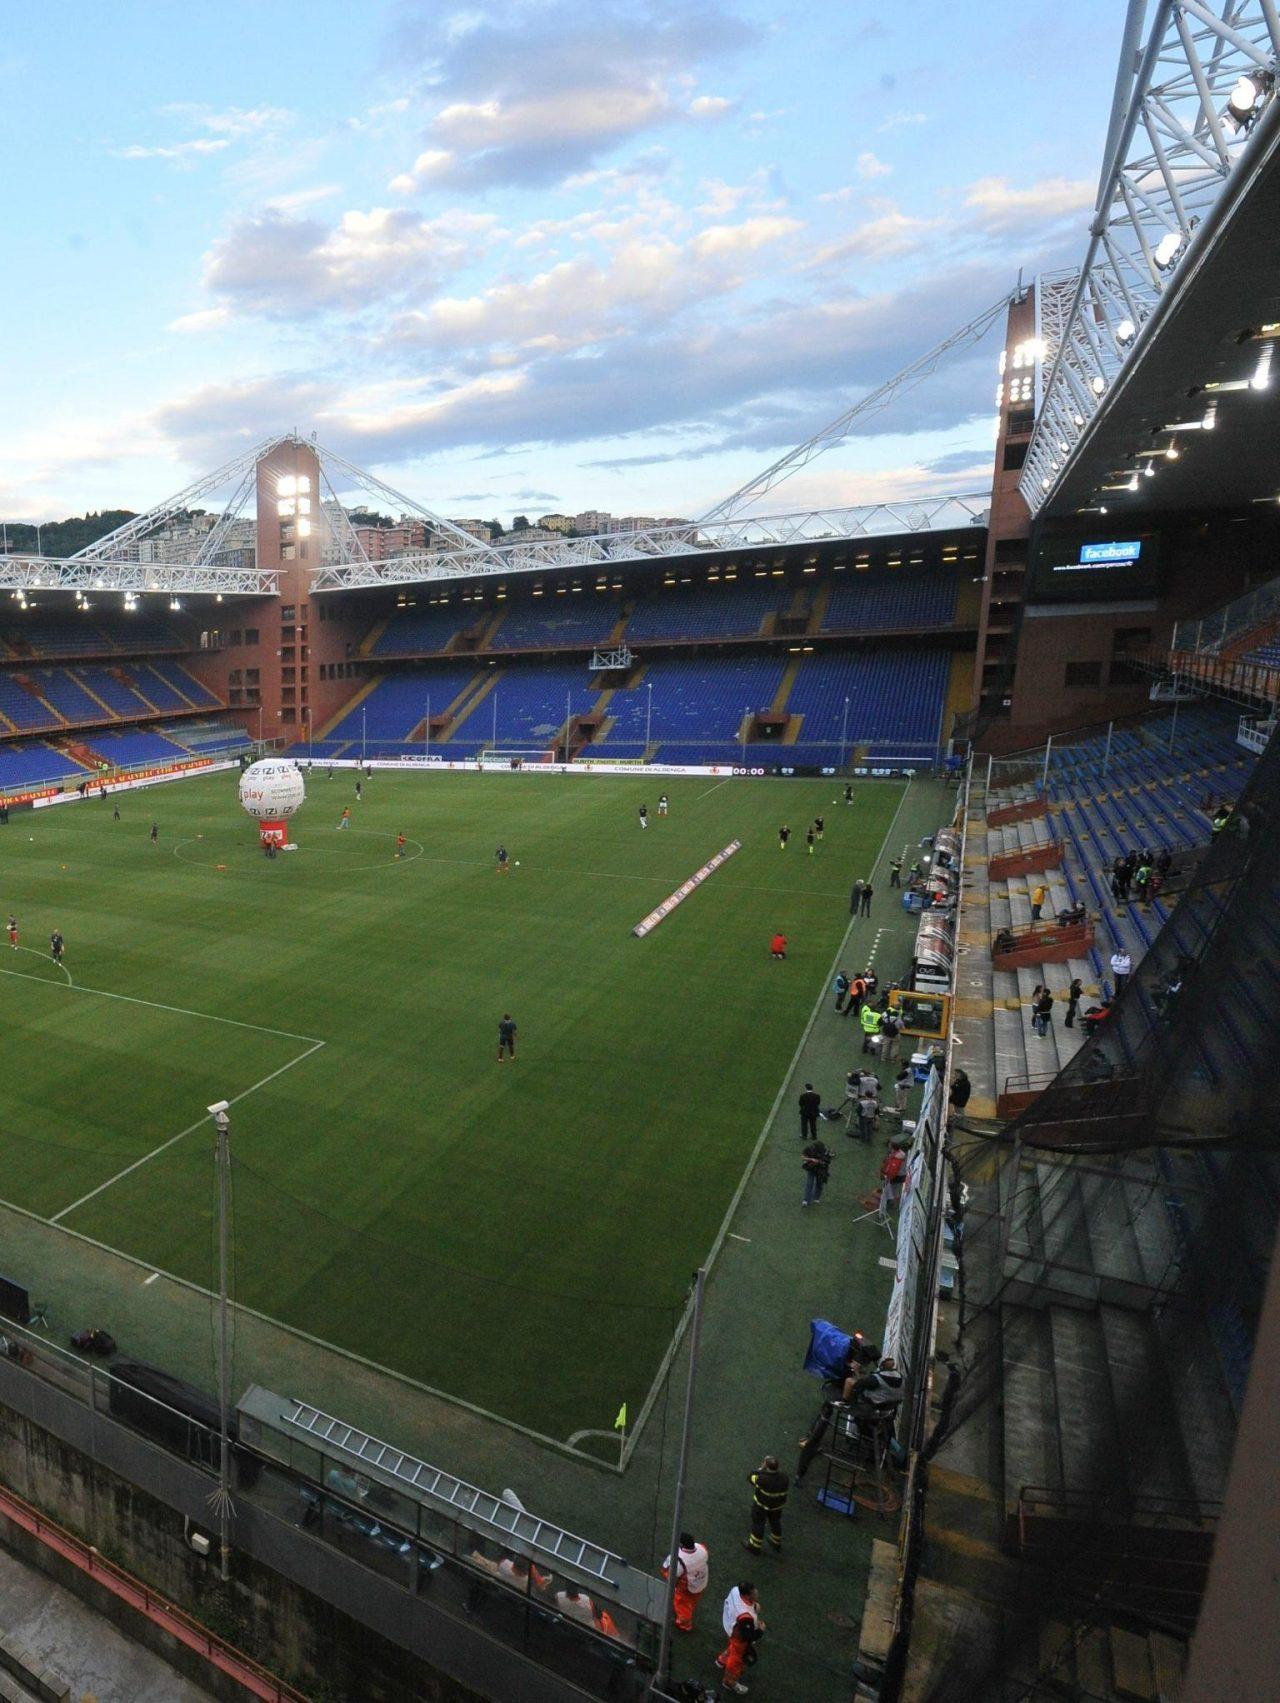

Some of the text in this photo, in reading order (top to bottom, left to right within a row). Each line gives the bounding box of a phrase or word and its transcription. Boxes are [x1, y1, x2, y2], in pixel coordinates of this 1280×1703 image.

[1086, 546, 1136, 558] facebook
[733, 767, 765, 776] 00:00
[243, 788, 264, 801] play
